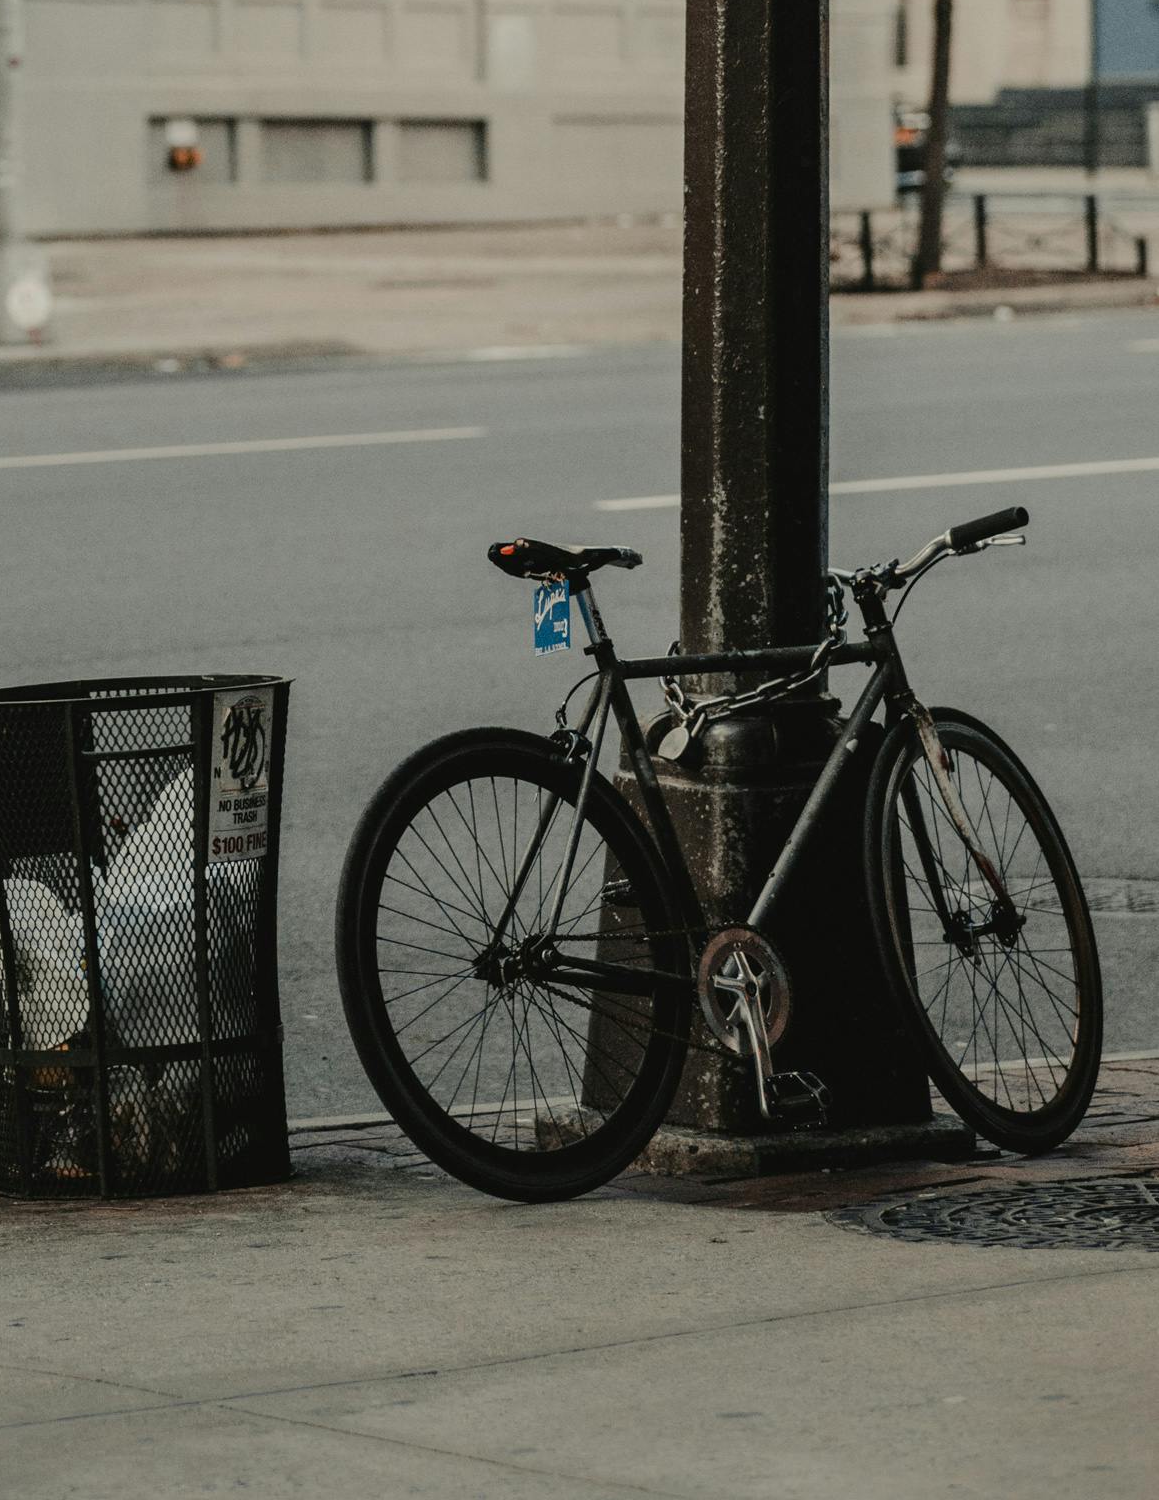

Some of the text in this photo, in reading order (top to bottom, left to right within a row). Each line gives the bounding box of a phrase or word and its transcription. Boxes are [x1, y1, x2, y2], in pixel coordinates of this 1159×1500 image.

[218, 794, 266, 812] NO BUSINESS
[232, 810, 258, 824] TRASH
[212, 831, 267, 856] $100 FINE
